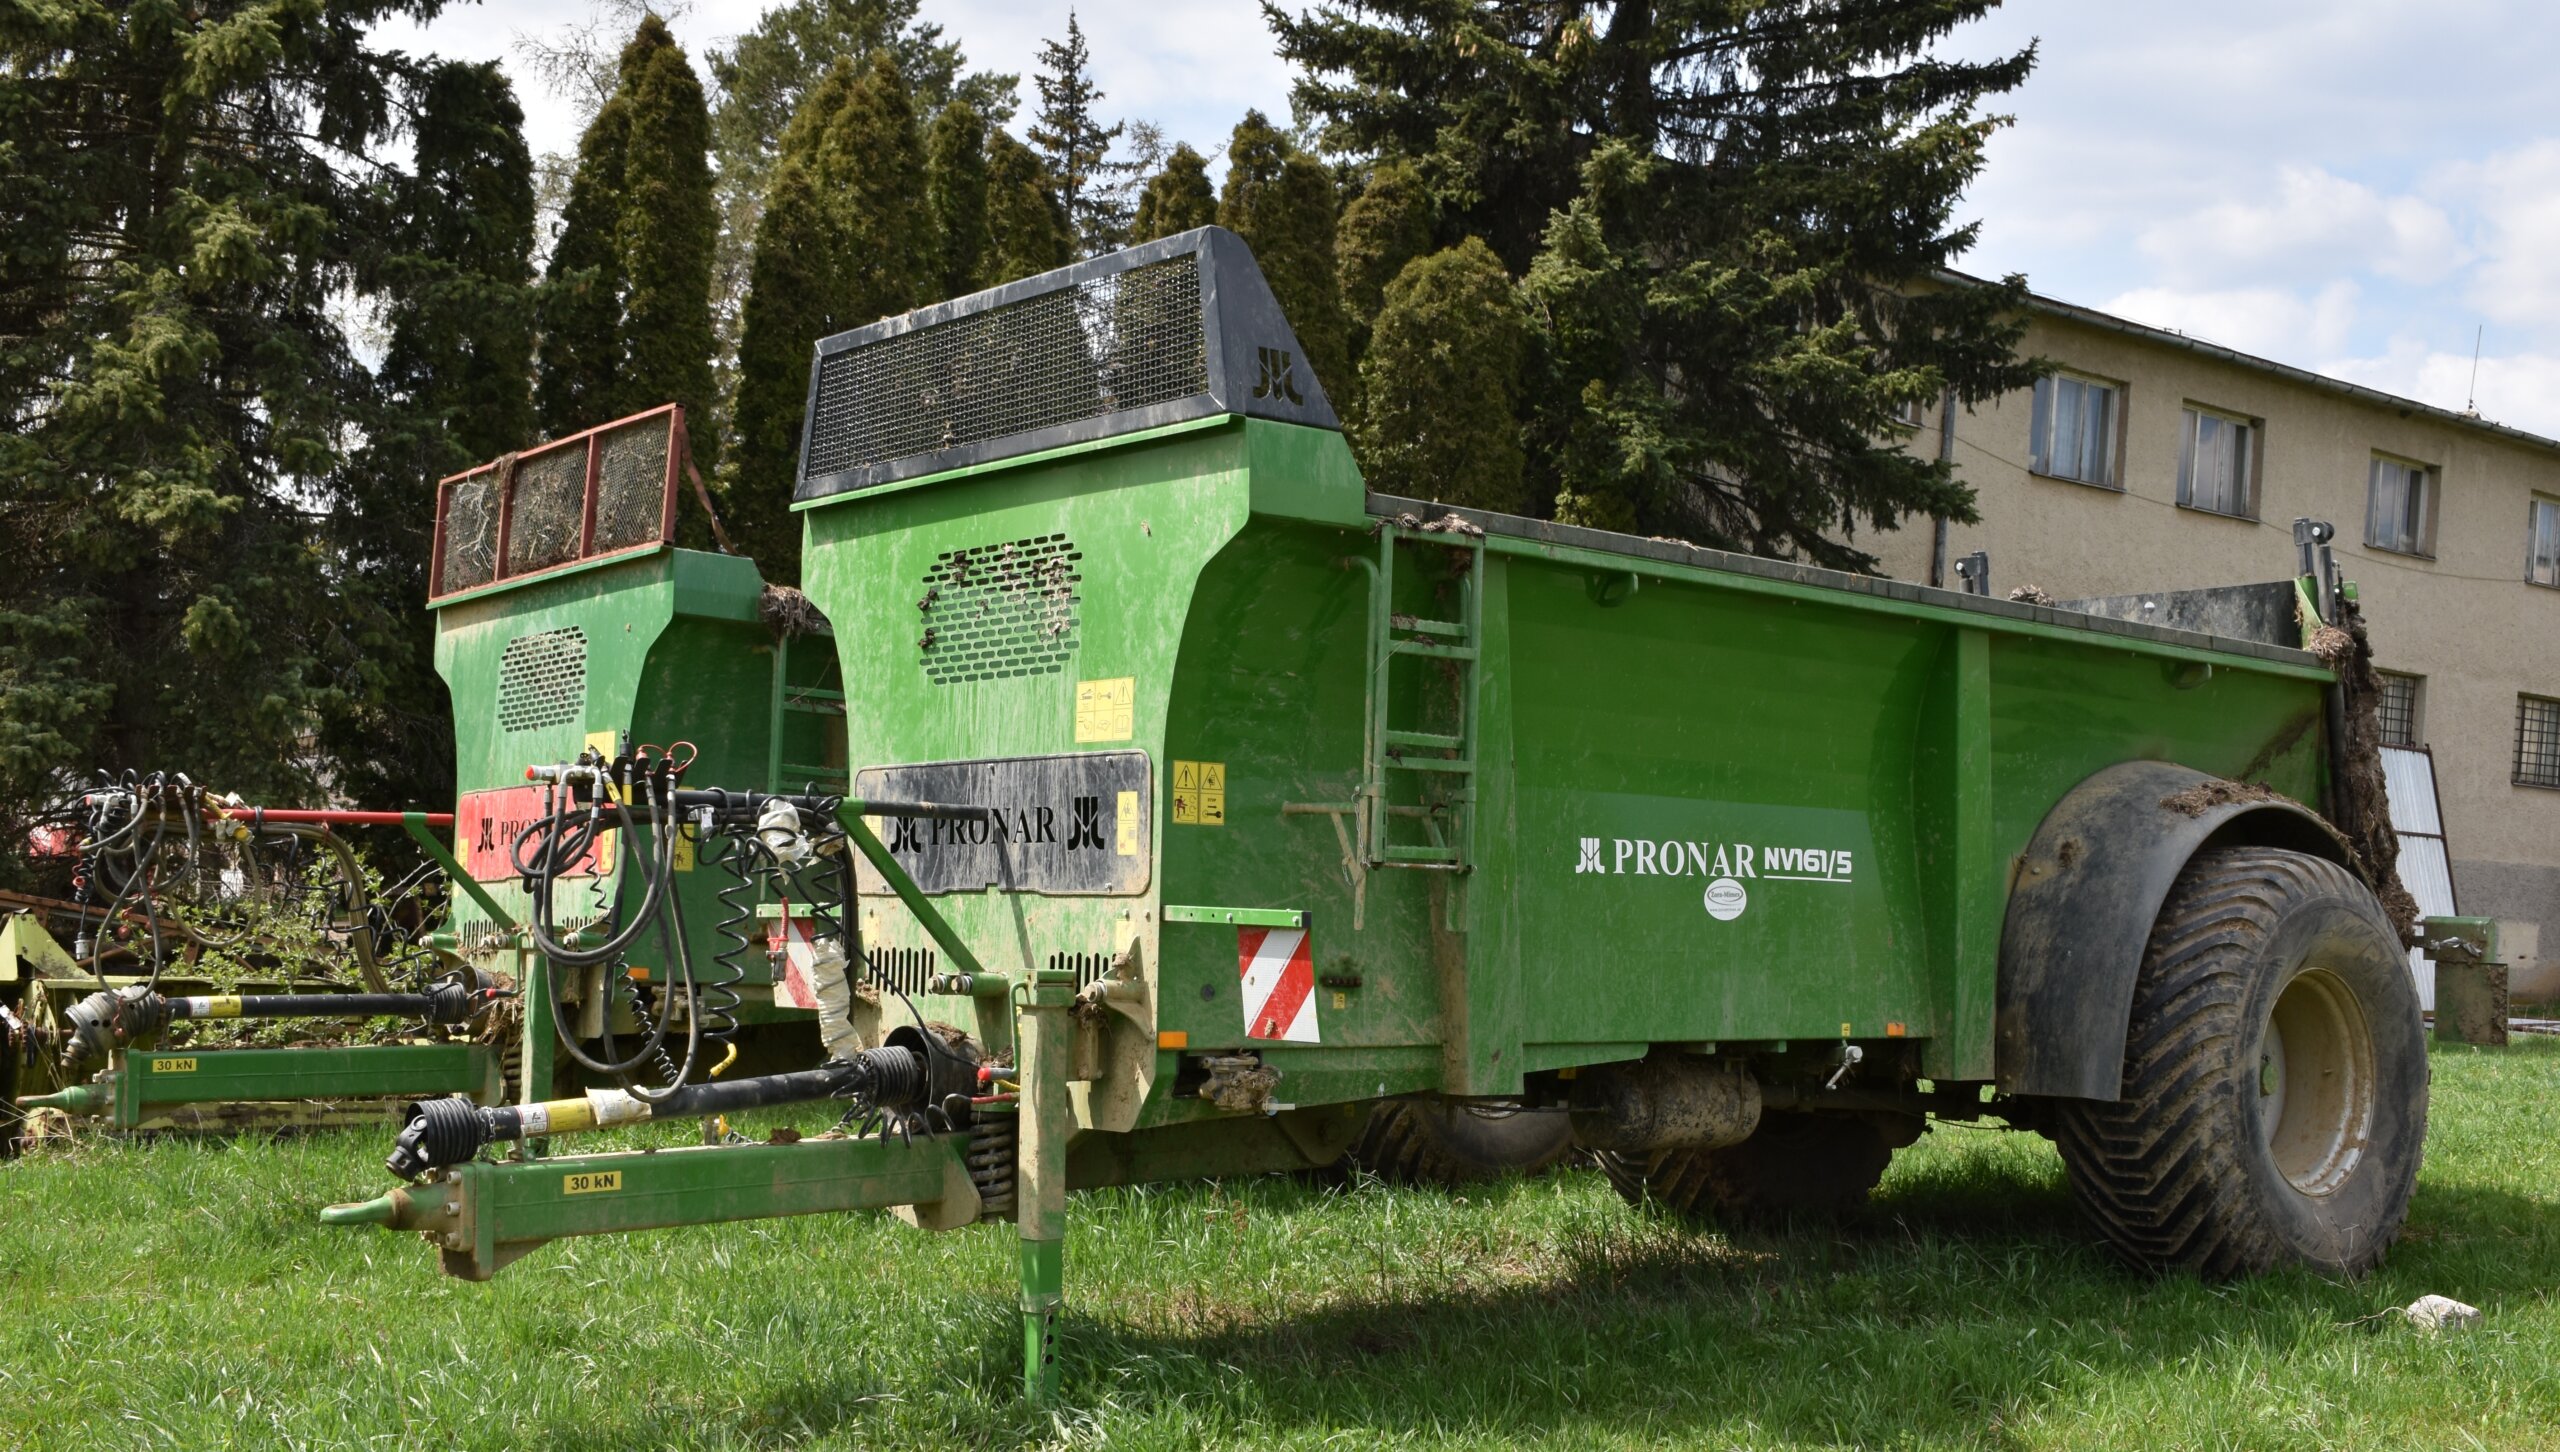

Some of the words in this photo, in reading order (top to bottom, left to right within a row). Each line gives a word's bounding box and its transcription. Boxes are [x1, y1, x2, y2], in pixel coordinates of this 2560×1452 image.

[931, 806, 1057, 845] PRONAR
[1612, 838, 1757, 878] PRONAR
[1764, 846, 1852, 879] NV161/5
[157, 1060, 172, 1071] 30
[176, 1059, 192, 1070] kN
[571, 1176, 589, 1191] 30
[594, 1174, 614, 1188] kN
